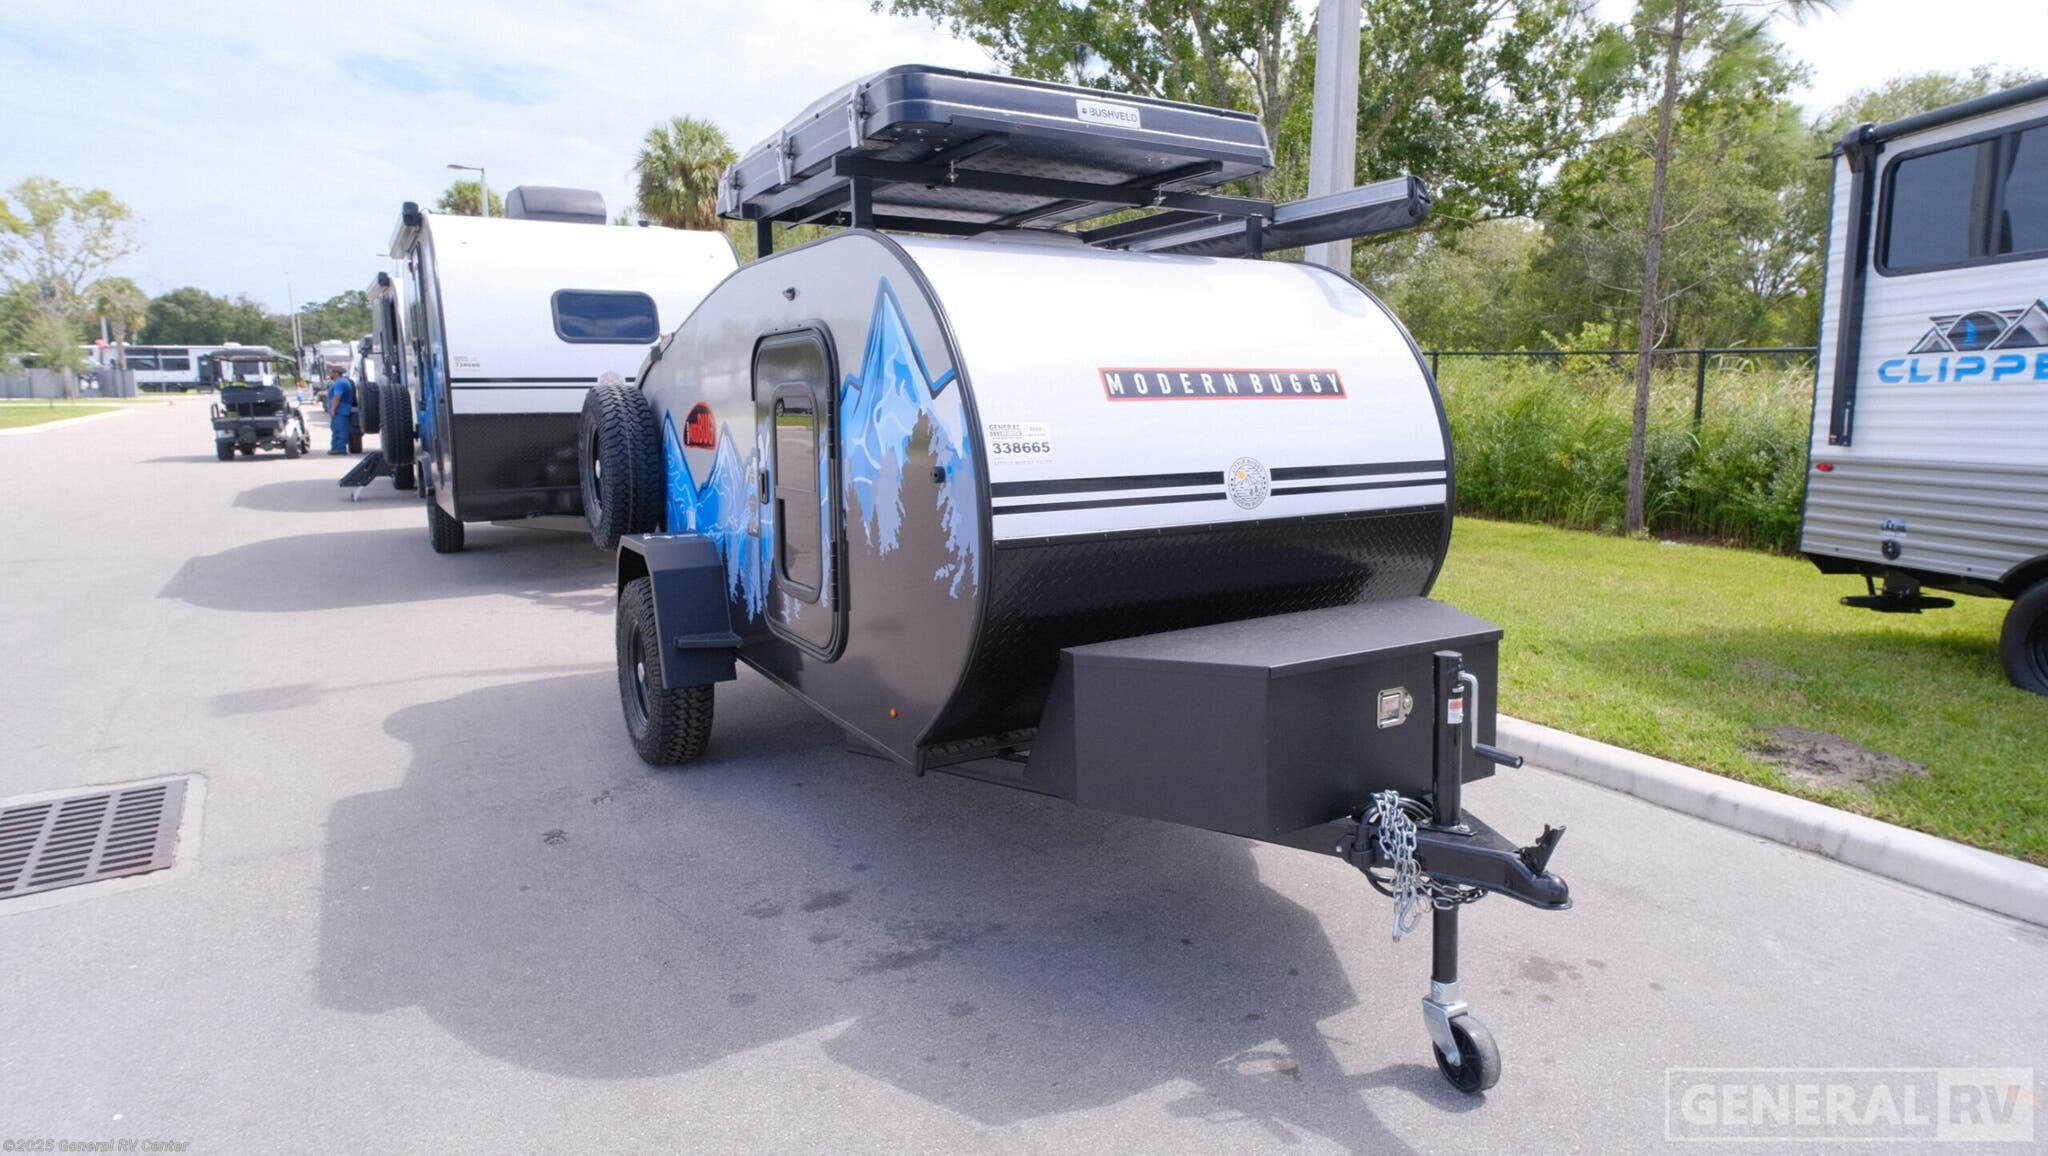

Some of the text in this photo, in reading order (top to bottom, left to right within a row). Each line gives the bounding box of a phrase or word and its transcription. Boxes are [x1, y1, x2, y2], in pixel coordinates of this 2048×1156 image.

[1089, 107, 1138, 122] BUSHVELD
[1105, 373, 1340, 395] MODERN BUGGY
[992, 441, 1051, 454] 338665
